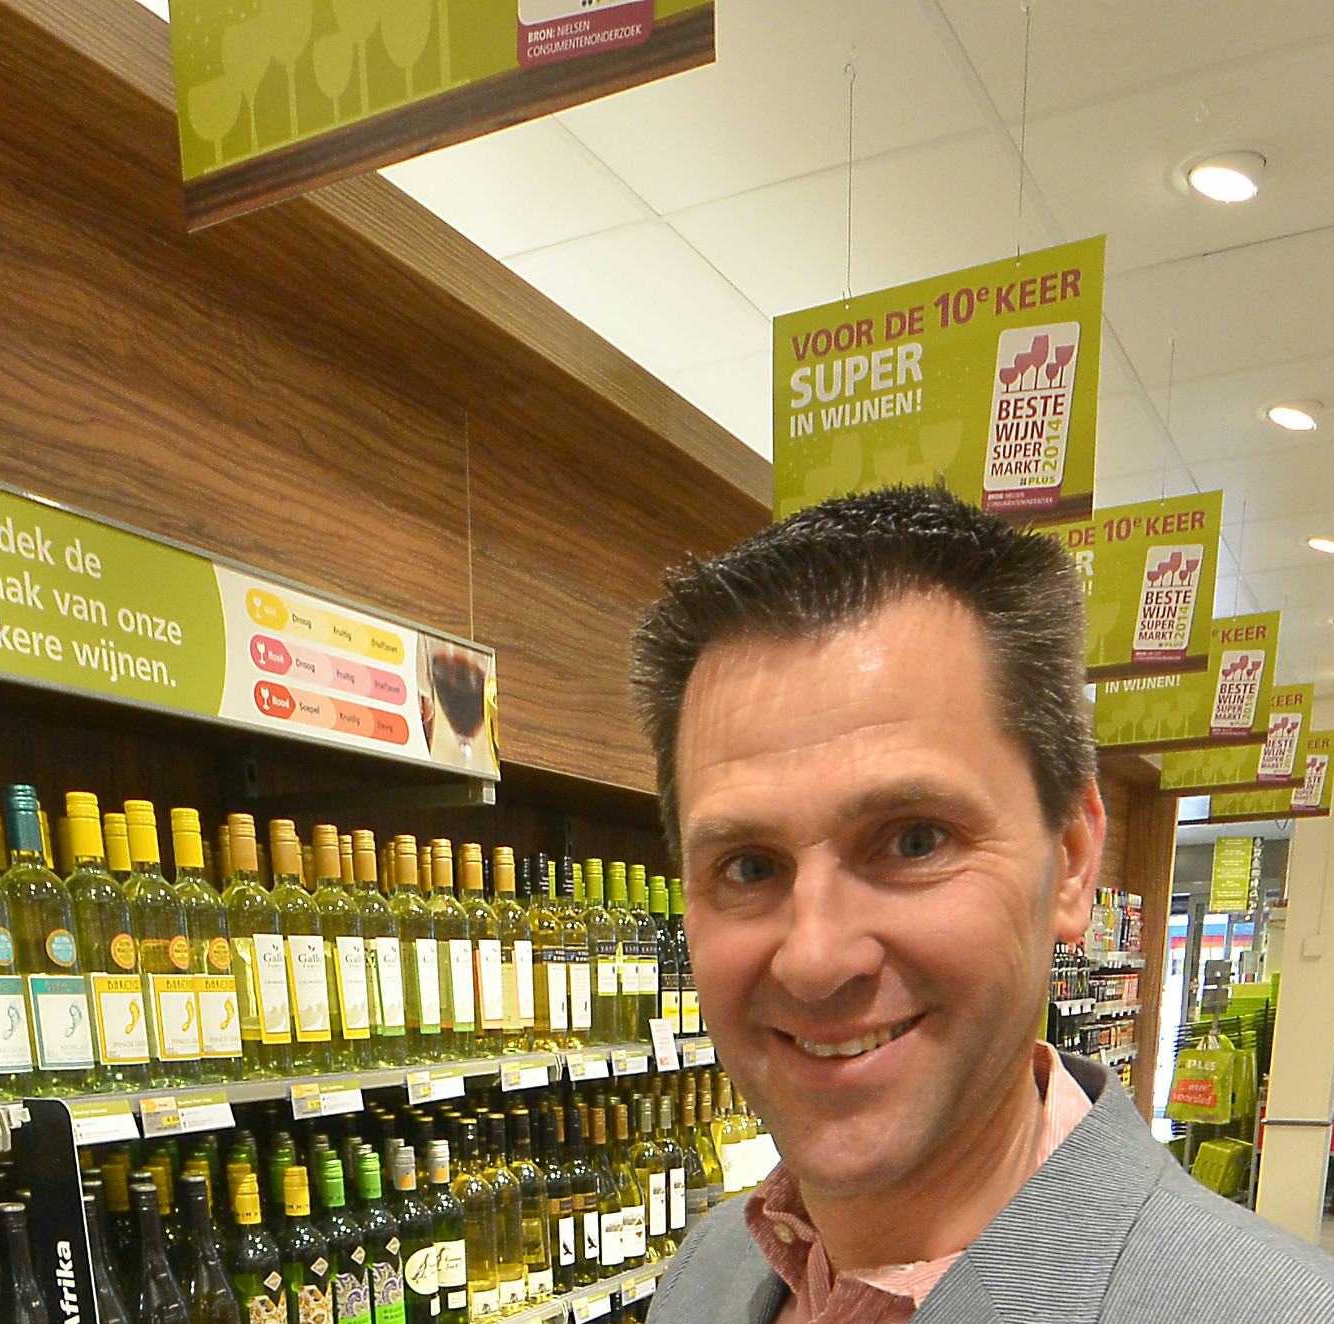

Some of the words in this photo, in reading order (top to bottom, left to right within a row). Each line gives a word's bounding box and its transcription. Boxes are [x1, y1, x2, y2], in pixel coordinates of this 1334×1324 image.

[527, 29, 555, 43] BRON:
[557, 20, 590, 37] NIELSEN
[527, 24, 642, 59] CONSUMENTENONDERZOEK
[792, 319, 874, 361] VOOR
[885, 306, 925, 341] DE
[995, 269, 1081, 315] KEER
[791, 343, 923, 409] SUPER
[791, 412, 813, 438] IN
[821, 388, 922, 430] WIJNEN!
[998, 394, 1065, 421] BESTE
[996, 420, 1045, 443] WIJN
[993, 442, 1041, 460] SUPER
[1043, 419, 1062, 472] 2014
[991, 460, 1040, 476] MARKT
[1028, 476, 1056, 485] PLUS
[1067, 527, 1096, 547] DE
[1146, 511, 1205, 536] KEER
[65, 538, 102, 579] de
[1145, 590, 1192, 604] BESTE
[53, 589, 108, 625] van
[118, 605, 182, 645] onze
[1143, 605, 1177, 619] WIJN
[292, 614, 312, 629] Droog
[1141, 620, 1175, 630] SUPER
[1175, 606, 1188, 639] 2014
[333, 627, 352, 641] Fruitig
[1139, 631, 1173, 641] MARKT
[1221, 626, 1267, 643] KEER
[72, 639, 178, 686] wijnen.
[296, 659, 315, 672] Droog
[1106, 681, 1120, 693] IN
[1124, 674, 1180, 693] WIJNEN!
[1220, 683, 1256, 694] BESTE
[272, 696, 289, 708] Rood
[1218, 695, 1245, 704] WIJN
[1188, 1060, 1217, 1071] PLUS
